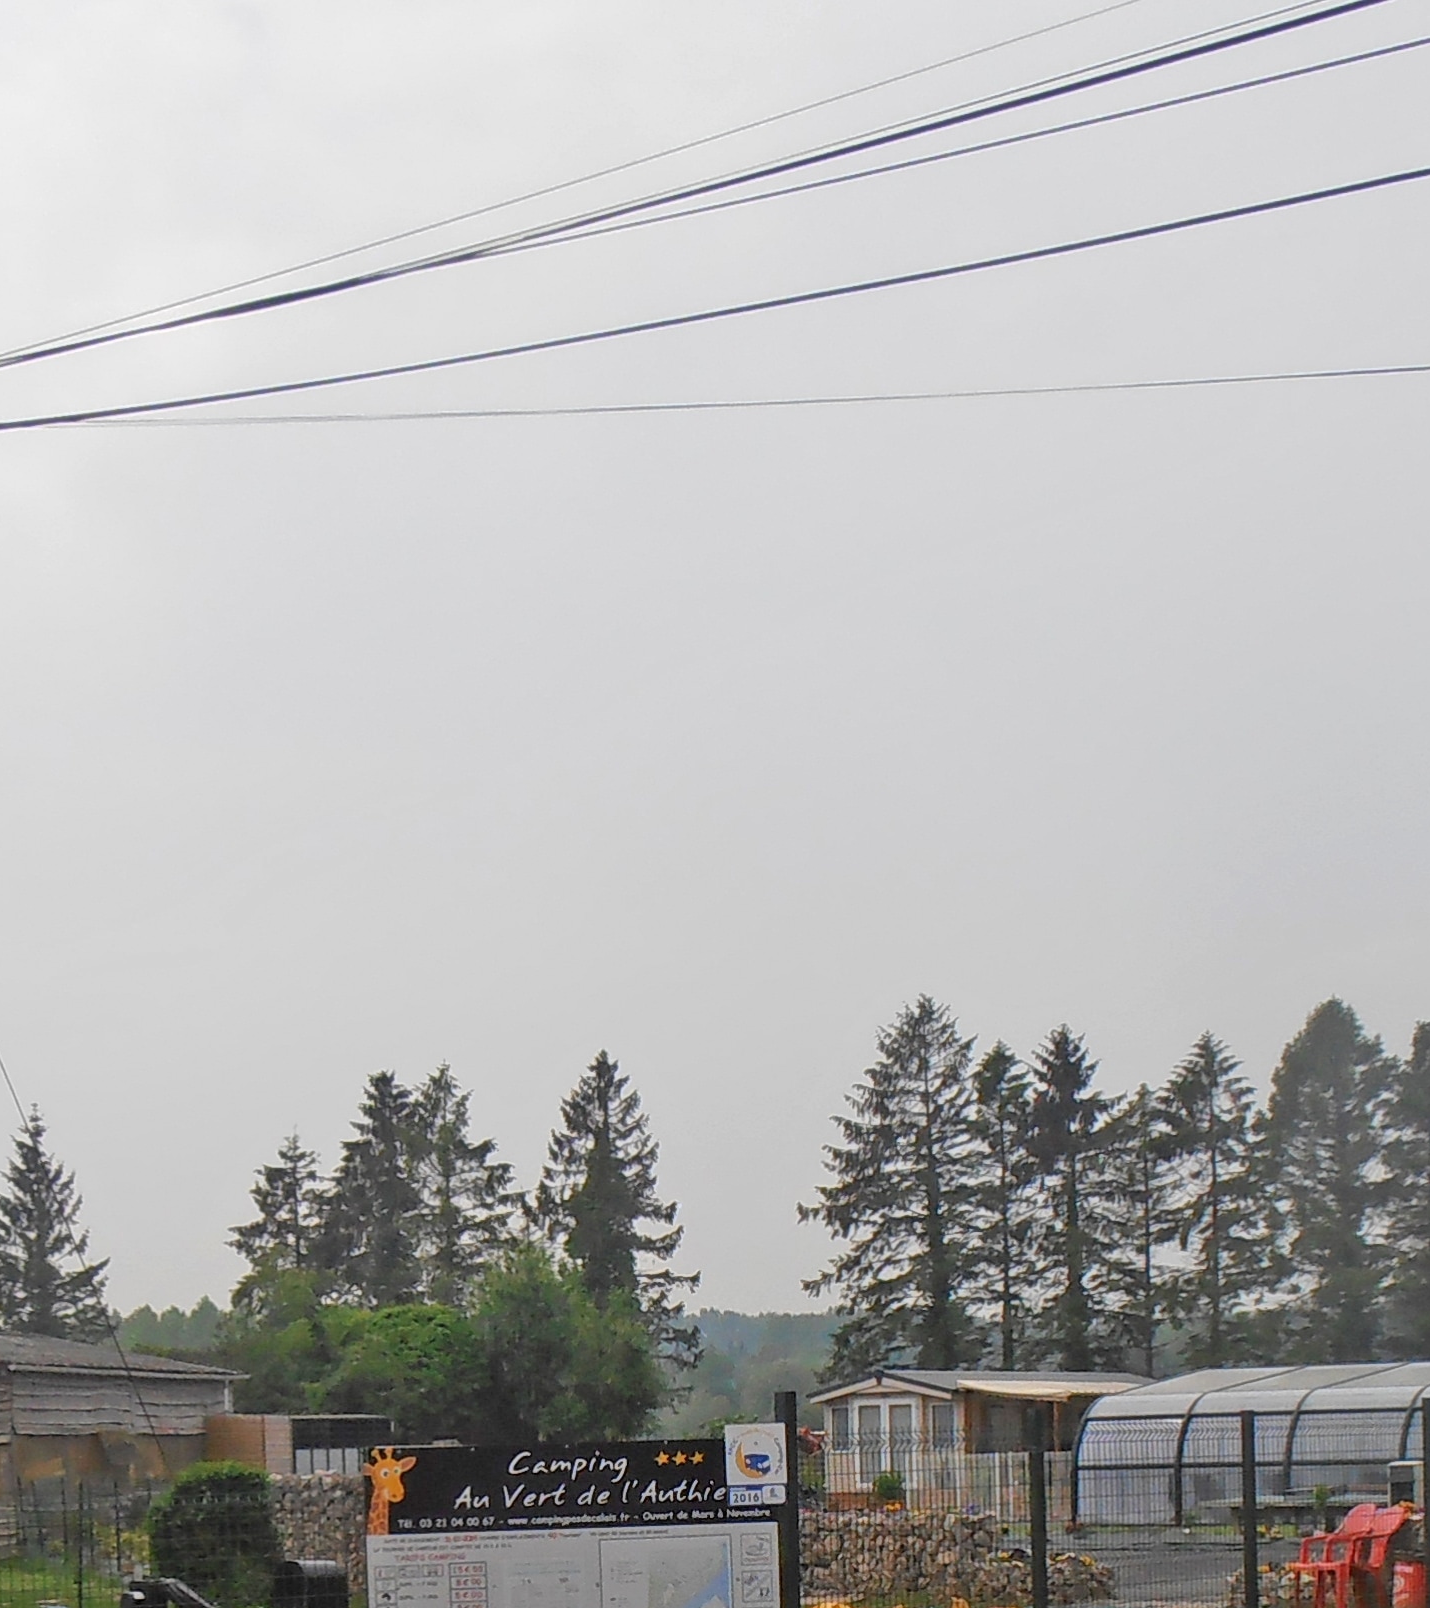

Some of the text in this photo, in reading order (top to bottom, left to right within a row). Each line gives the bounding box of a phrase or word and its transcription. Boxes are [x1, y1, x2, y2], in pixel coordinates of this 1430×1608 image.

[508, 1450, 628, 1483] Camping
[454, 1479, 727, 1510] Au Vert de l'Authie
[733, 1492, 760, 1503] 2016
[419, 1517, 432, 1528] 03
[435, 1517, 447, 1528] 21
[450, 1517, 463, 1527] 04
[466, 1516, 480, 1527] 00
[482, 1516, 495, 1526] 67
[642, 1510, 673, 1521] Ouvert
[677, 1509, 688, 1520] de
[691, 1509, 715, 1520] Mars
[717, 1508, 724, 1519] à
[726, 1507, 771, 1518] Novembre
